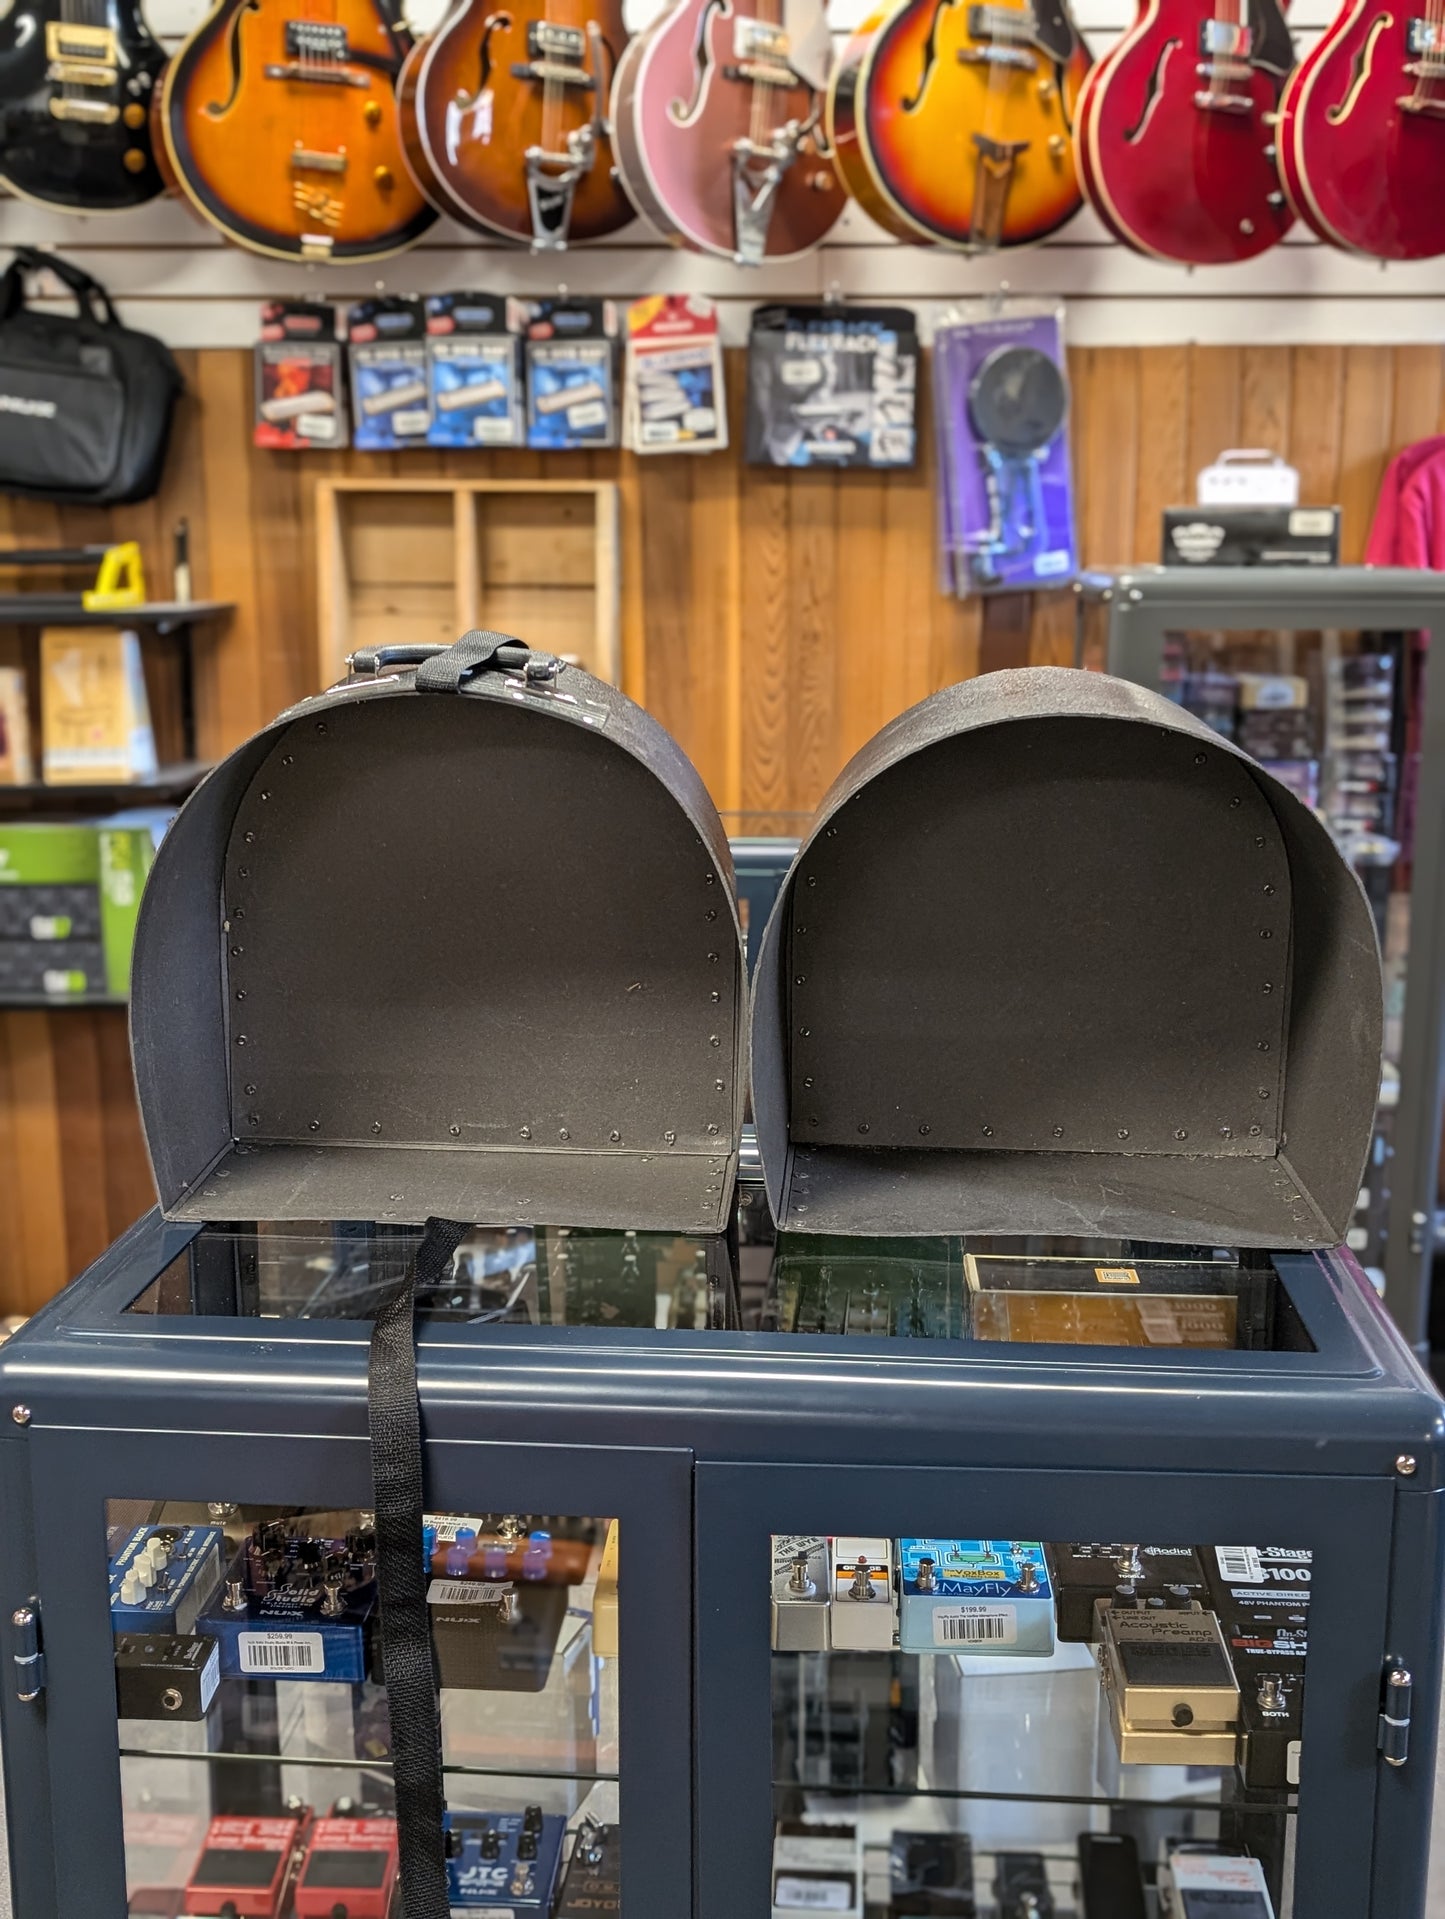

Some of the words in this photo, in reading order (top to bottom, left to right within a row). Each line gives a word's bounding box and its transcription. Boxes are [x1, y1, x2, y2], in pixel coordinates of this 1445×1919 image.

[778, 1545, 796, 1557] THE
[796, 1537, 819, 1548] WYE
[115, 1542, 139, 1566] PHANTOM
[281, 1583, 320, 1596] Solid
[942, 1582, 1011, 1597] MayFly
[263, 1590, 316, 1603] Studio
[1119, 1621, 1189, 1629] Acoustic
[1152, 1628, 1213, 1637] Preamp
